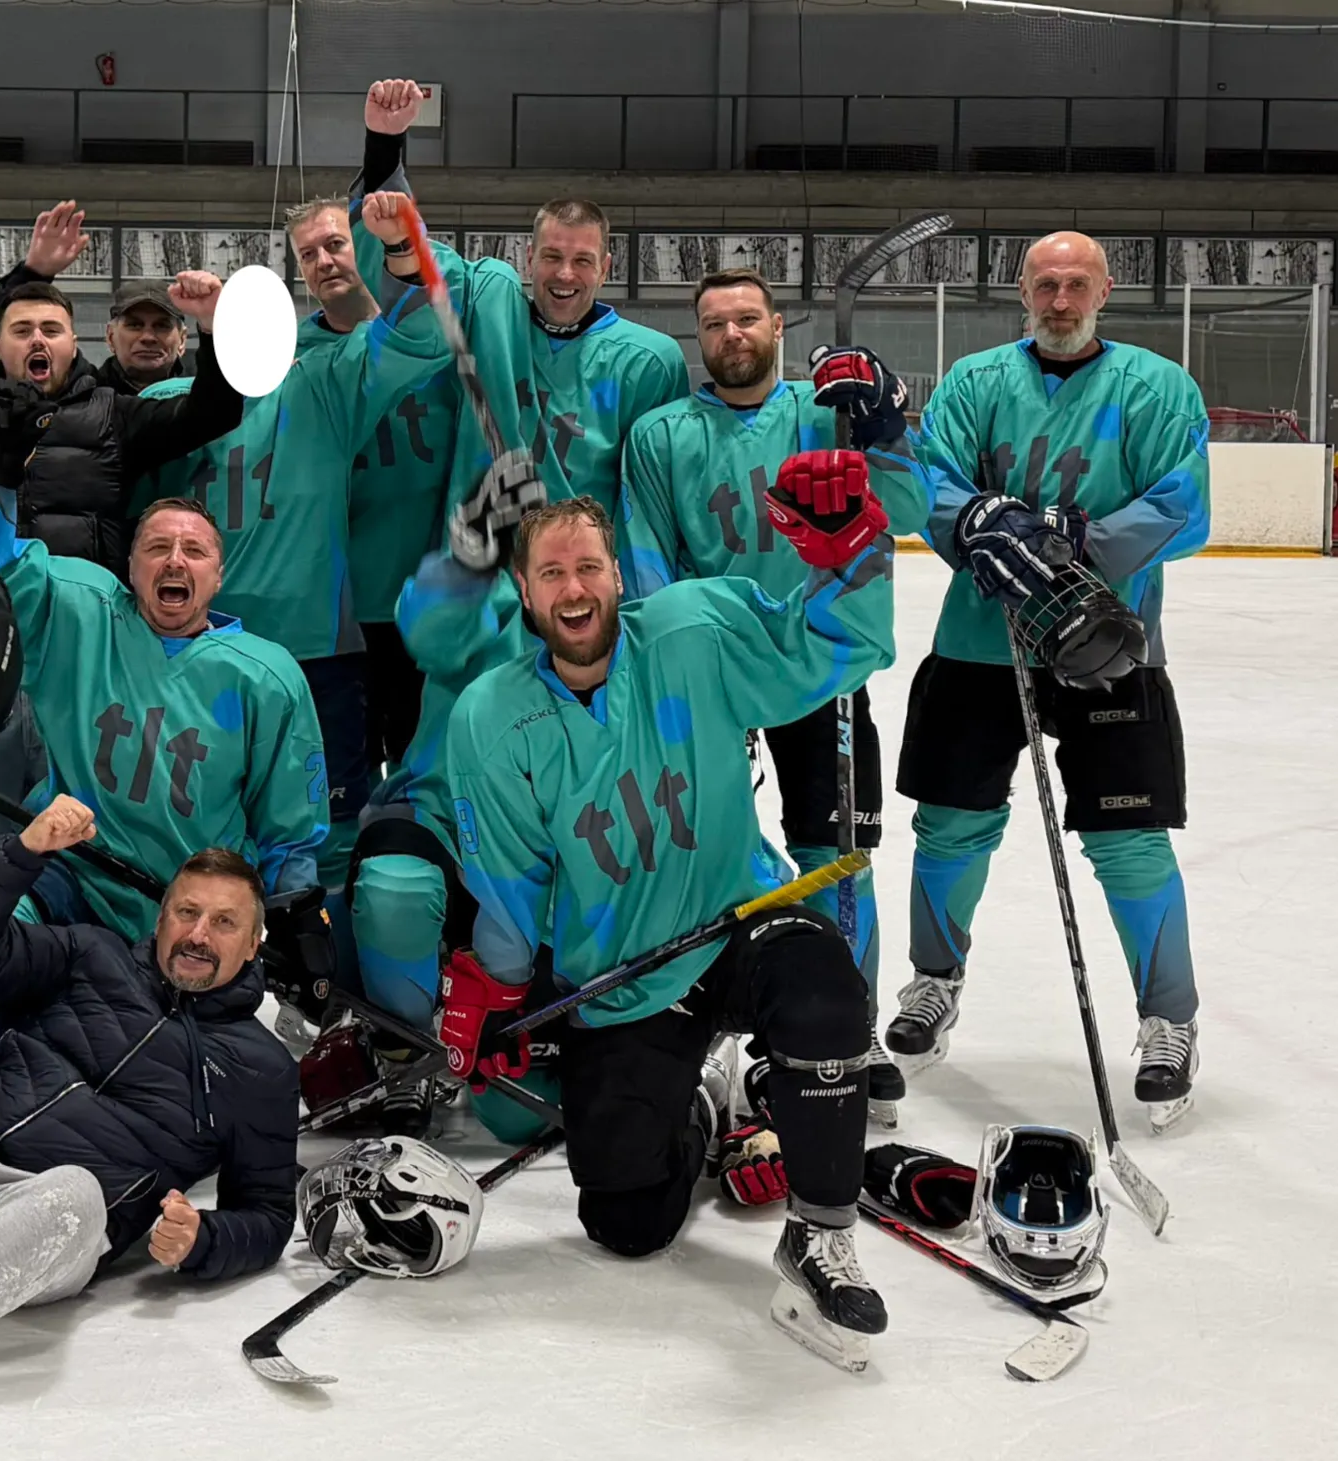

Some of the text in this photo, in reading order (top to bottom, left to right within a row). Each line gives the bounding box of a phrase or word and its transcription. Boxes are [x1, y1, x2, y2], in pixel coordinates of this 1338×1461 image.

[992, 434, 1091, 513] tlt
[708, 465, 775, 555] tl
[512, 707, 558, 732] TACKL
[1092, 710, 1138, 723] CCM
[94, 702, 209, 818] tlt
[573, 764, 699, 886] tlt
[1103, 796, 1149, 808] CCM
[526, 1043, 560, 1056] CM
